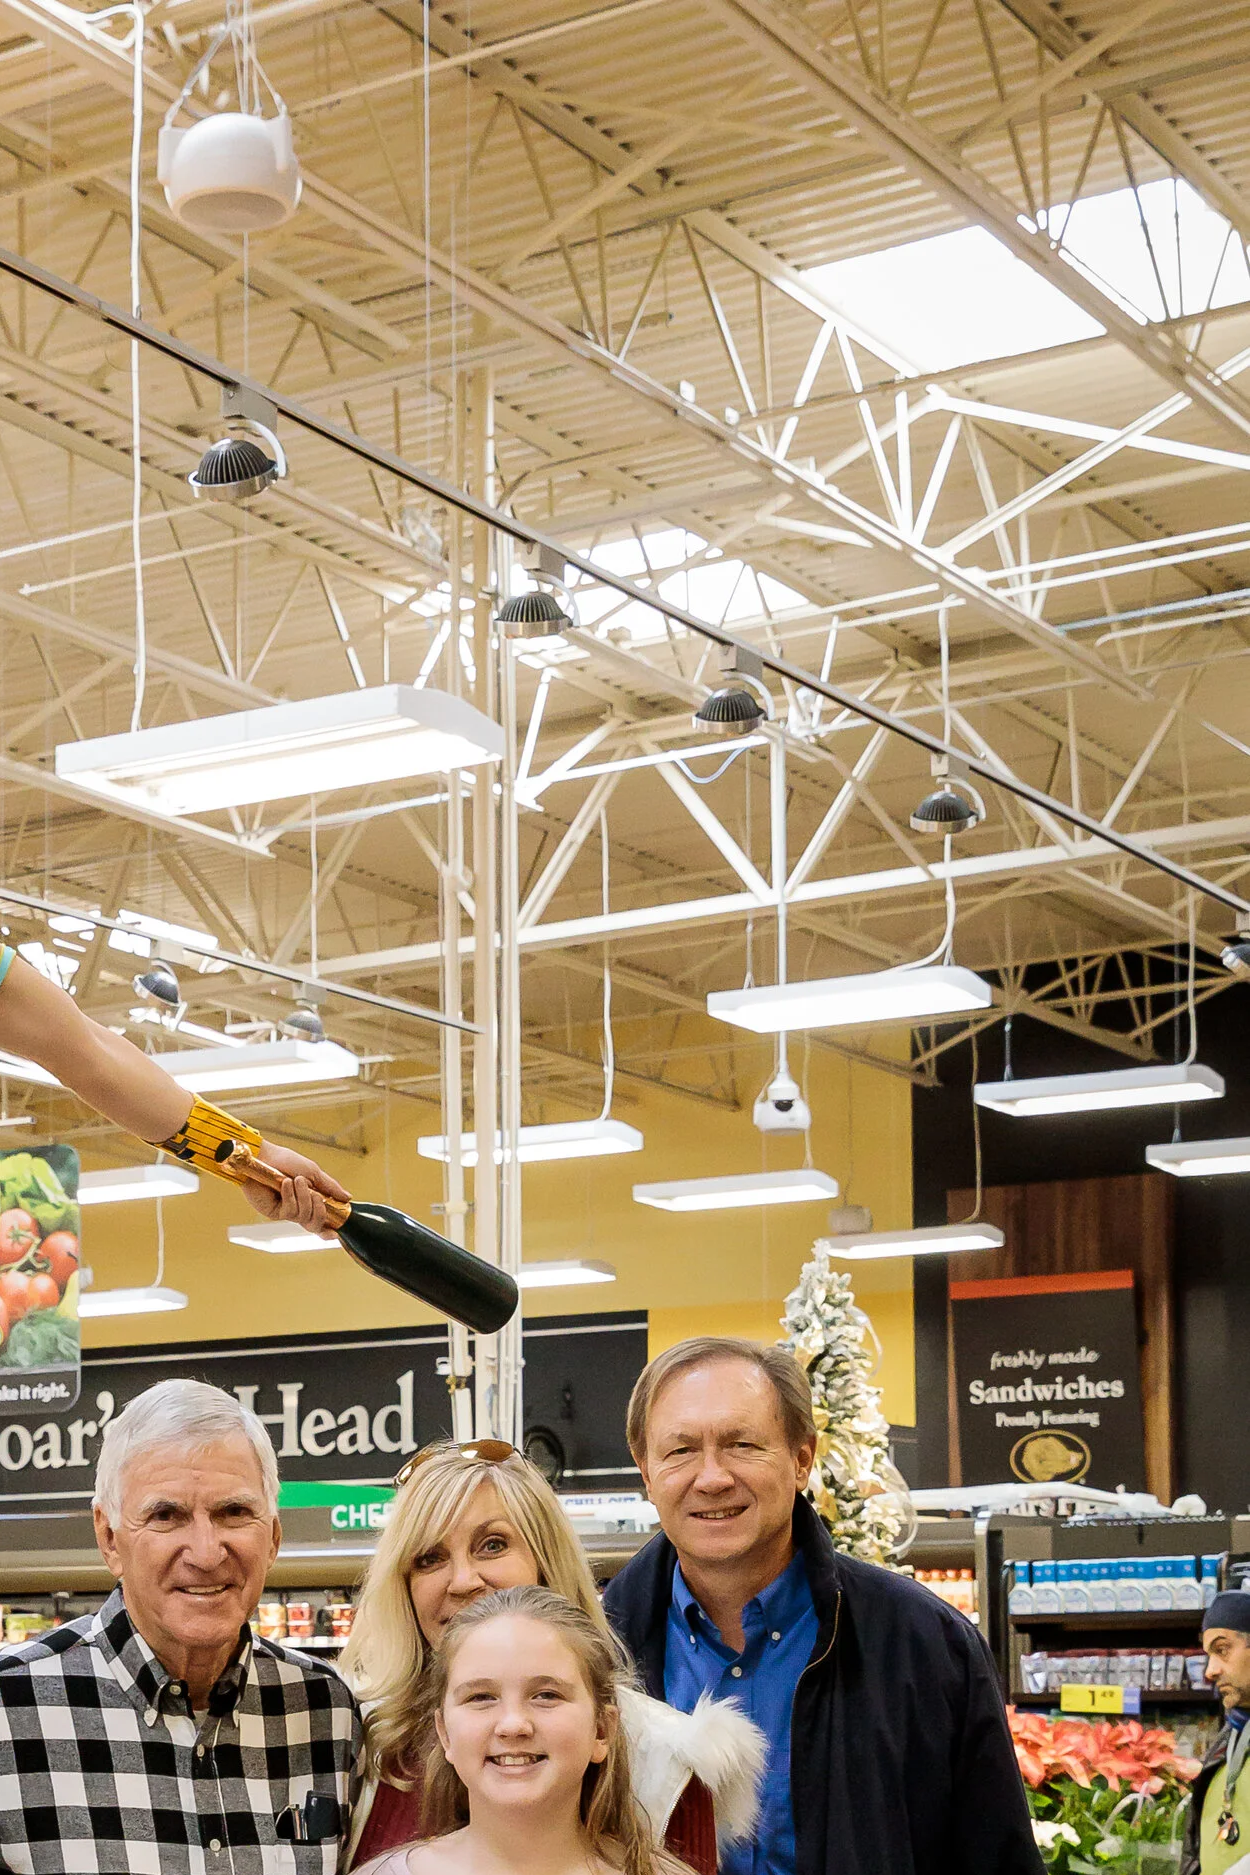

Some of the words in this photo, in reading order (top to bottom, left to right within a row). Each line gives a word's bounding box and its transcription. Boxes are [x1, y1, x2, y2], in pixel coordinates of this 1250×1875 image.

[990, 1349, 1046, 1371] freshly
[1048, 1346, 1101, 1365] made
[19, 1383, 31, 1400] it
[969, 1374, 1125, 1405] Sandwiches
[233, 1370, 418, 1458] Head
